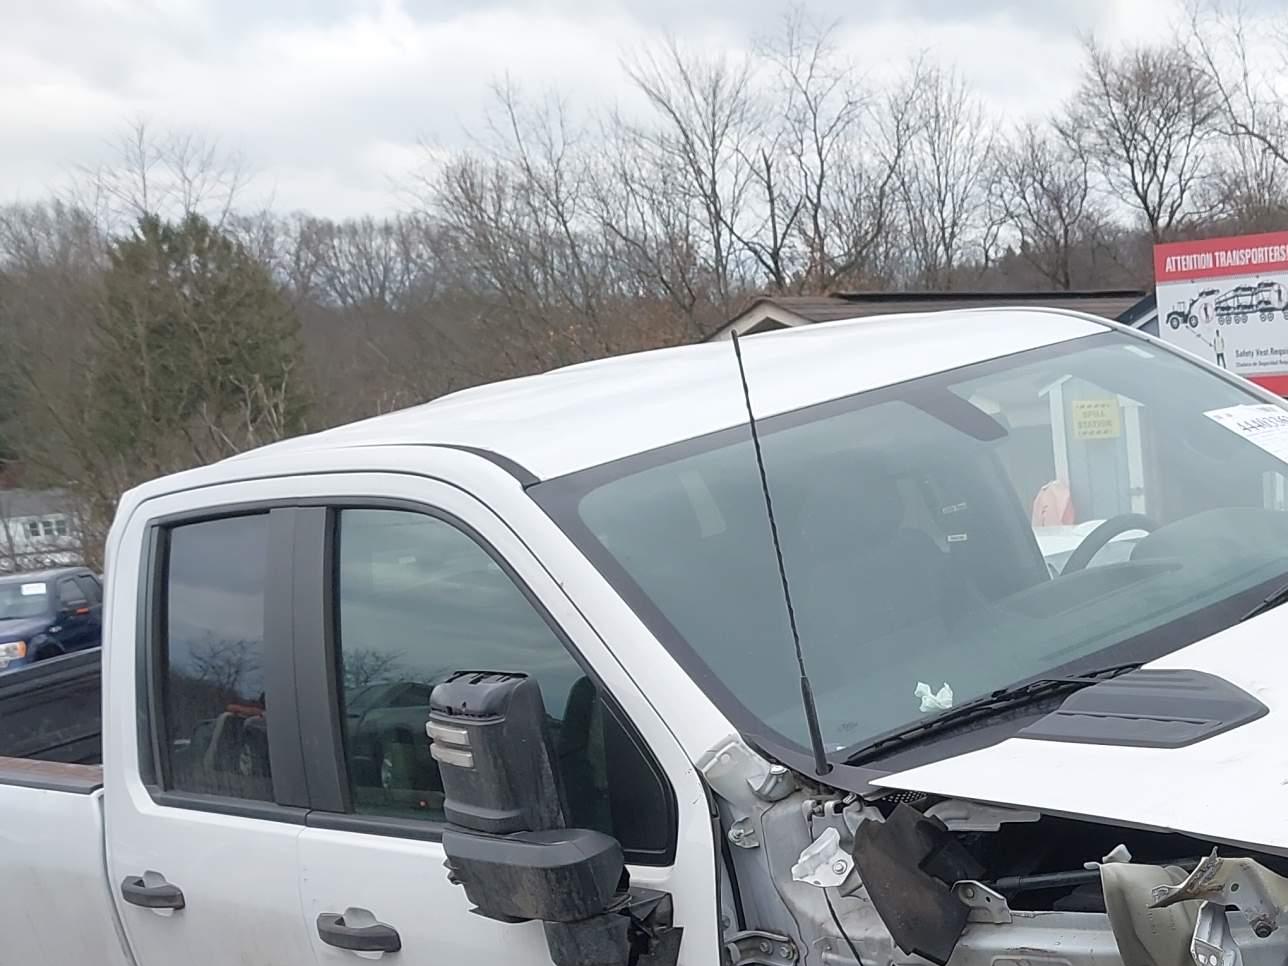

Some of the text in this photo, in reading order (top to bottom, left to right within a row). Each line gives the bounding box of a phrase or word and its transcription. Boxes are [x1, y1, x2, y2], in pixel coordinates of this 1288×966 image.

[1165, 252, 1213, 273] ATTENTION
[1235, 349, 1254, 359] Safety
[1255, 348, 1269, 356] Vest
[1082, 409, 1105, 418] SPILL
[1078, 419, 1112, 429] STATION
